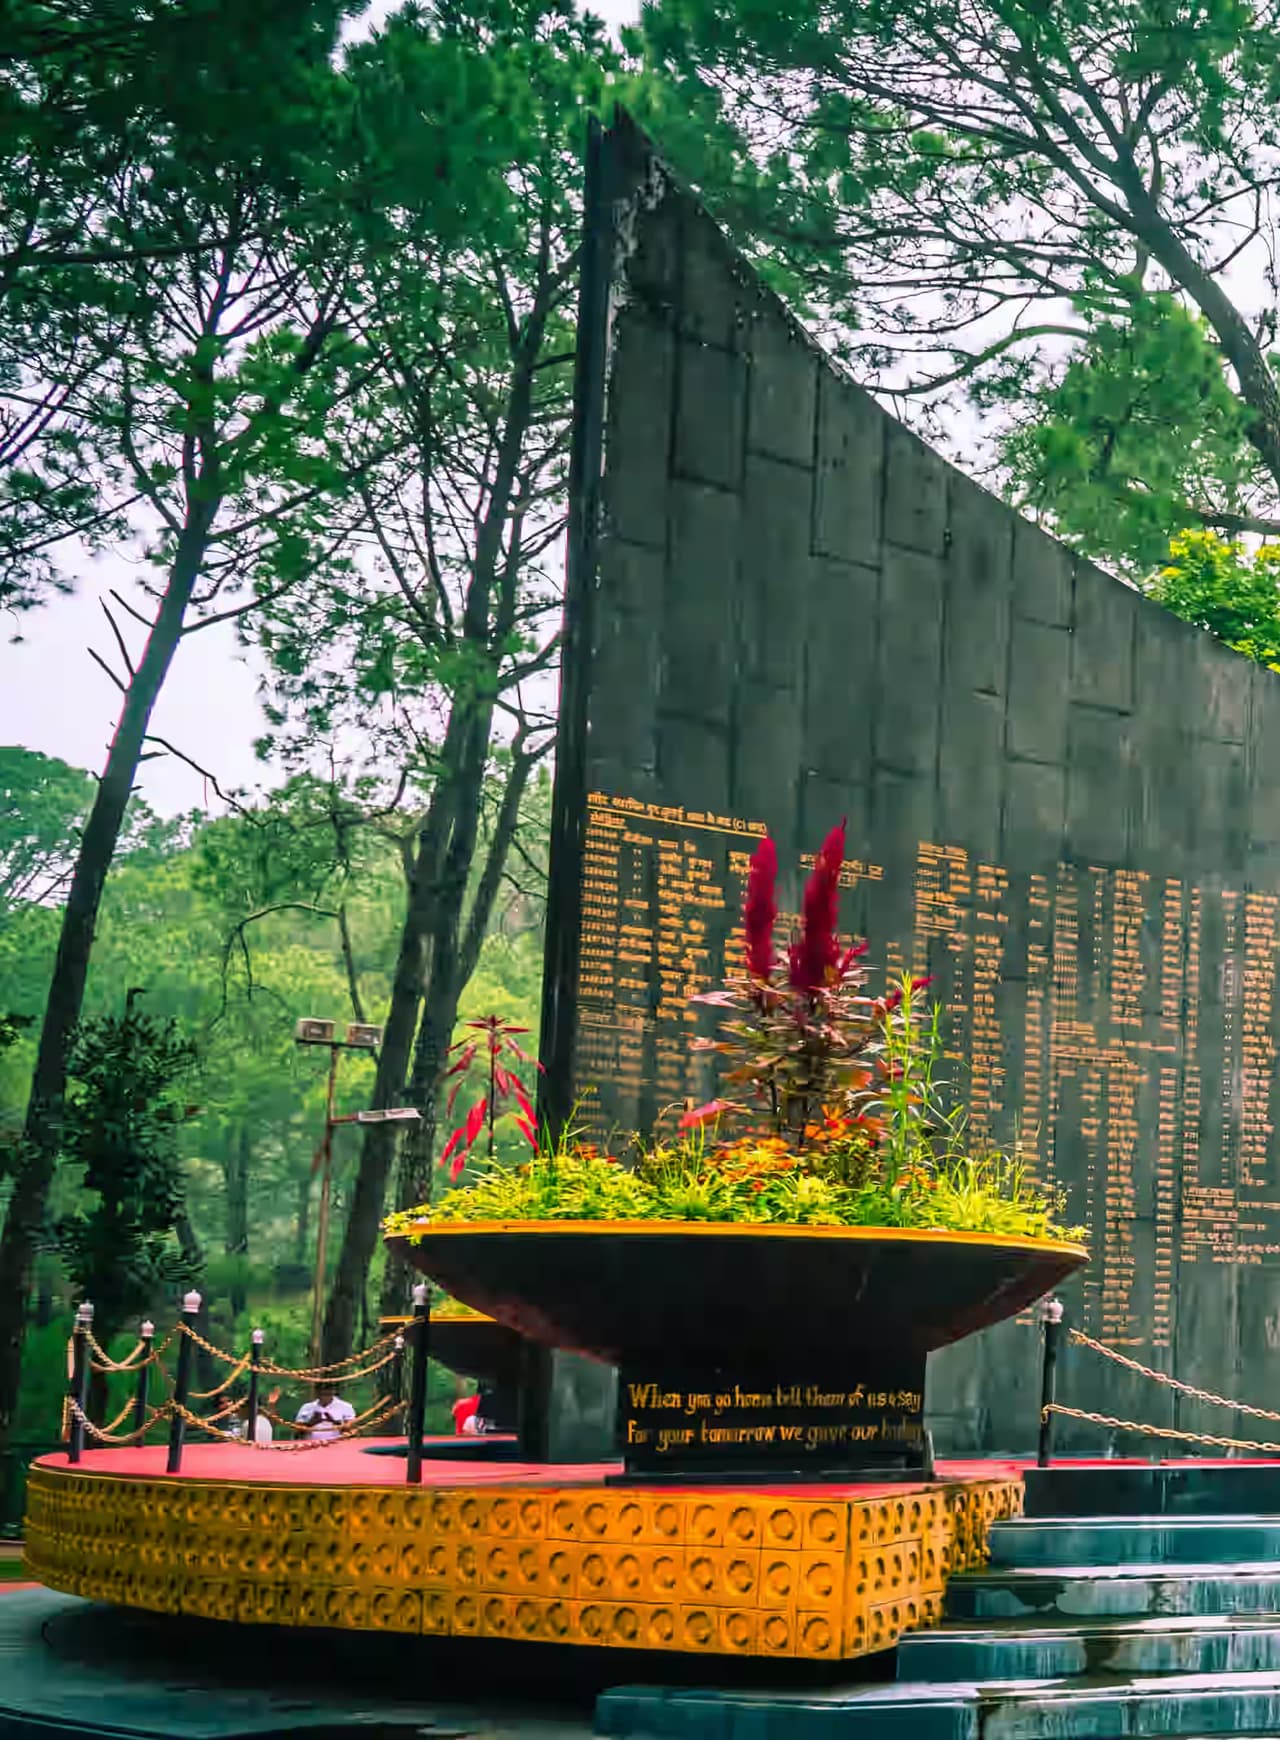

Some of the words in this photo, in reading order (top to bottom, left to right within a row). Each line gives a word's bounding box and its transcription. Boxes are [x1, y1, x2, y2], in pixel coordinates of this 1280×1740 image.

[629, 1383, 681, 1409] When
[714, 1393, 732, 1416] go
[779, 1425, 803, 1441] we
[851, 1425, 879, 1441] our
